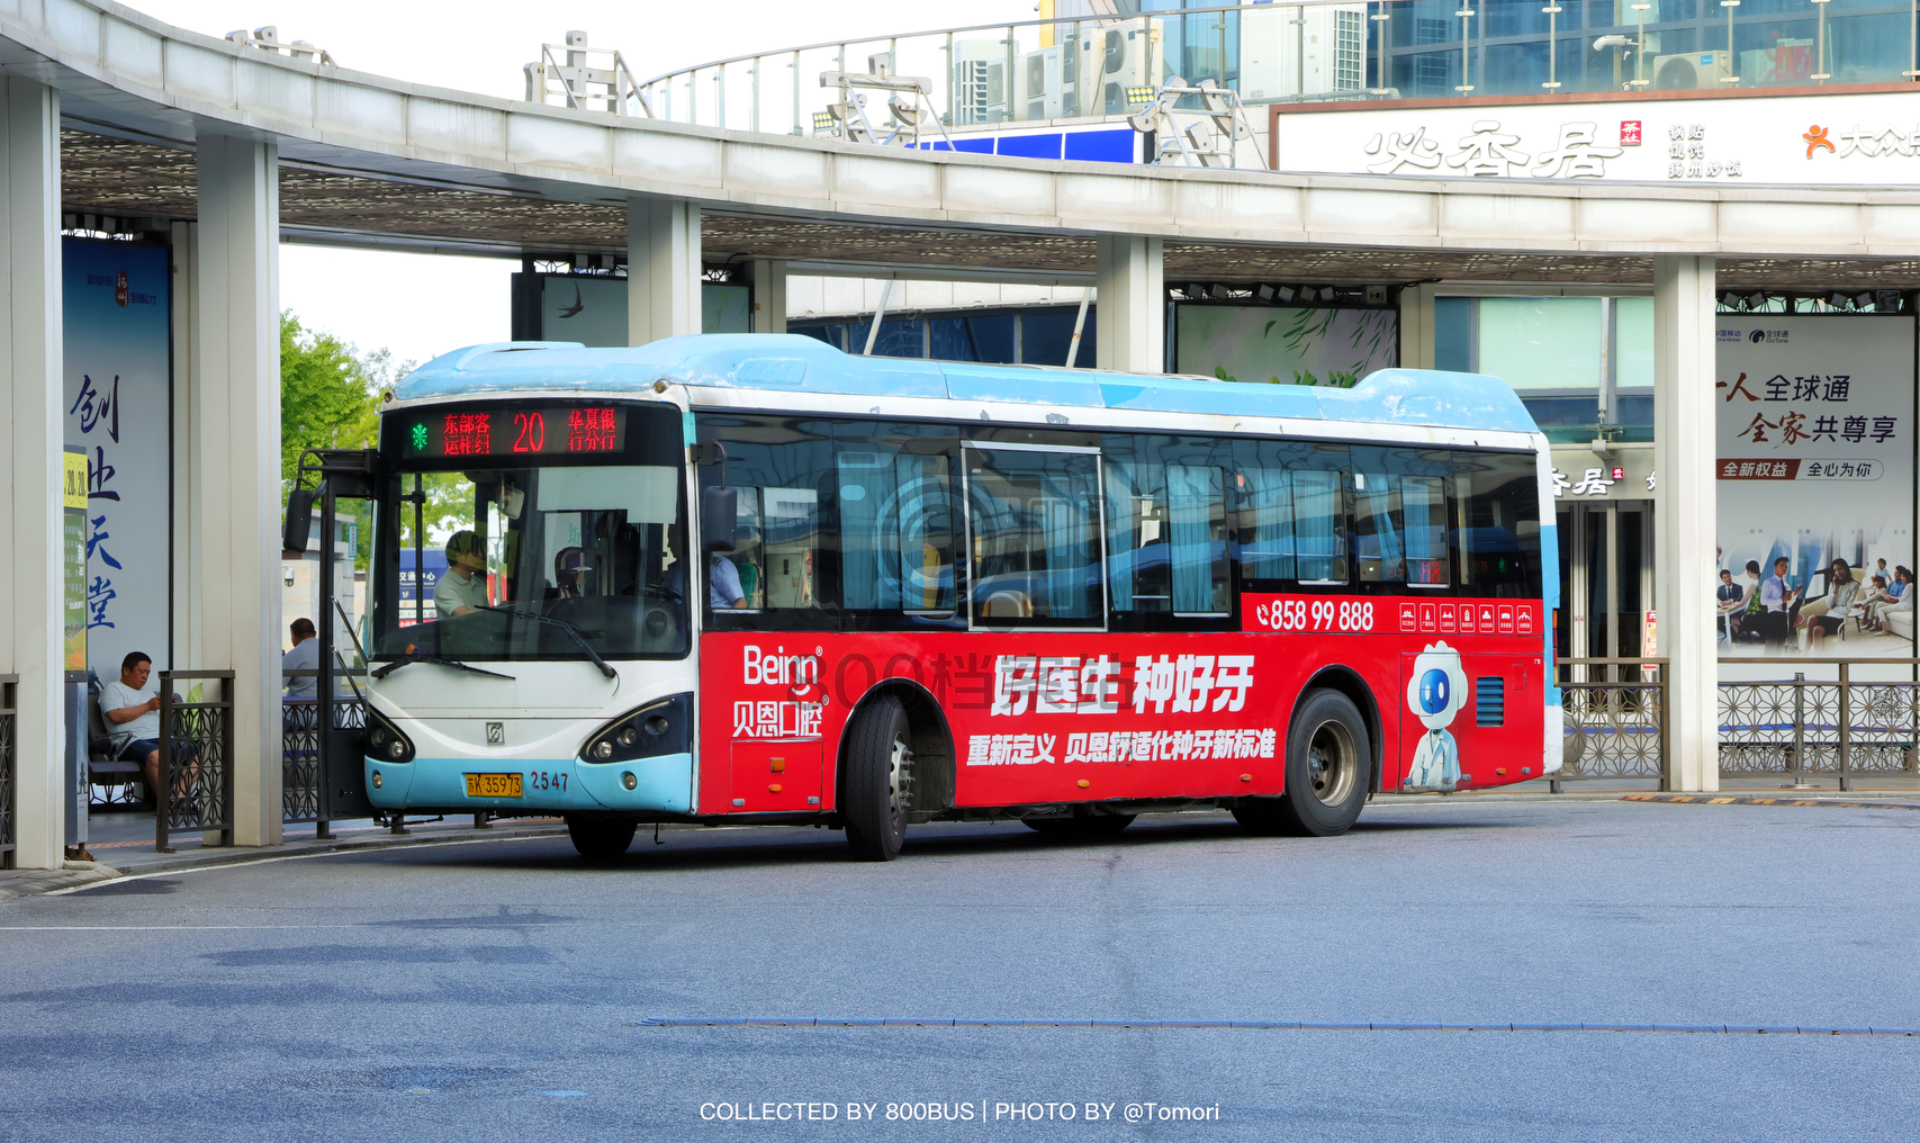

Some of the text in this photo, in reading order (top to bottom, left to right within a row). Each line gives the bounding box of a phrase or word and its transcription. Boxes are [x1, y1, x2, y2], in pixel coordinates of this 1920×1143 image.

[1363, 119, 1624, 178] 必香居
[1668, 143, 1705, 160] 馄饨
[1668, 160, 1742, 179] 扬州炒饭
[1766, 329, 1789, 338] 全球通
[443, 413, 491, 434] 东部客
[567, 408, 616, 430] 华夏银
[1737, 411, 1898, 449] 全家共尊享
[512, 412, 545, 453] 20
[567, 430, 616, 452] 行分行
[1722, 462, 1872, 478] 全新权益 全心为你
[70, 374, 122, 630] 创业天堂
[1271, 600, 1374, 631] 858 99 888
[990, 654, 1256, 717] 好医生 种好牙
[966, 728, 1277, 767] 重新定义 贝恩舒适化种牙新标准
[530, 770, 568, 792] 2547
